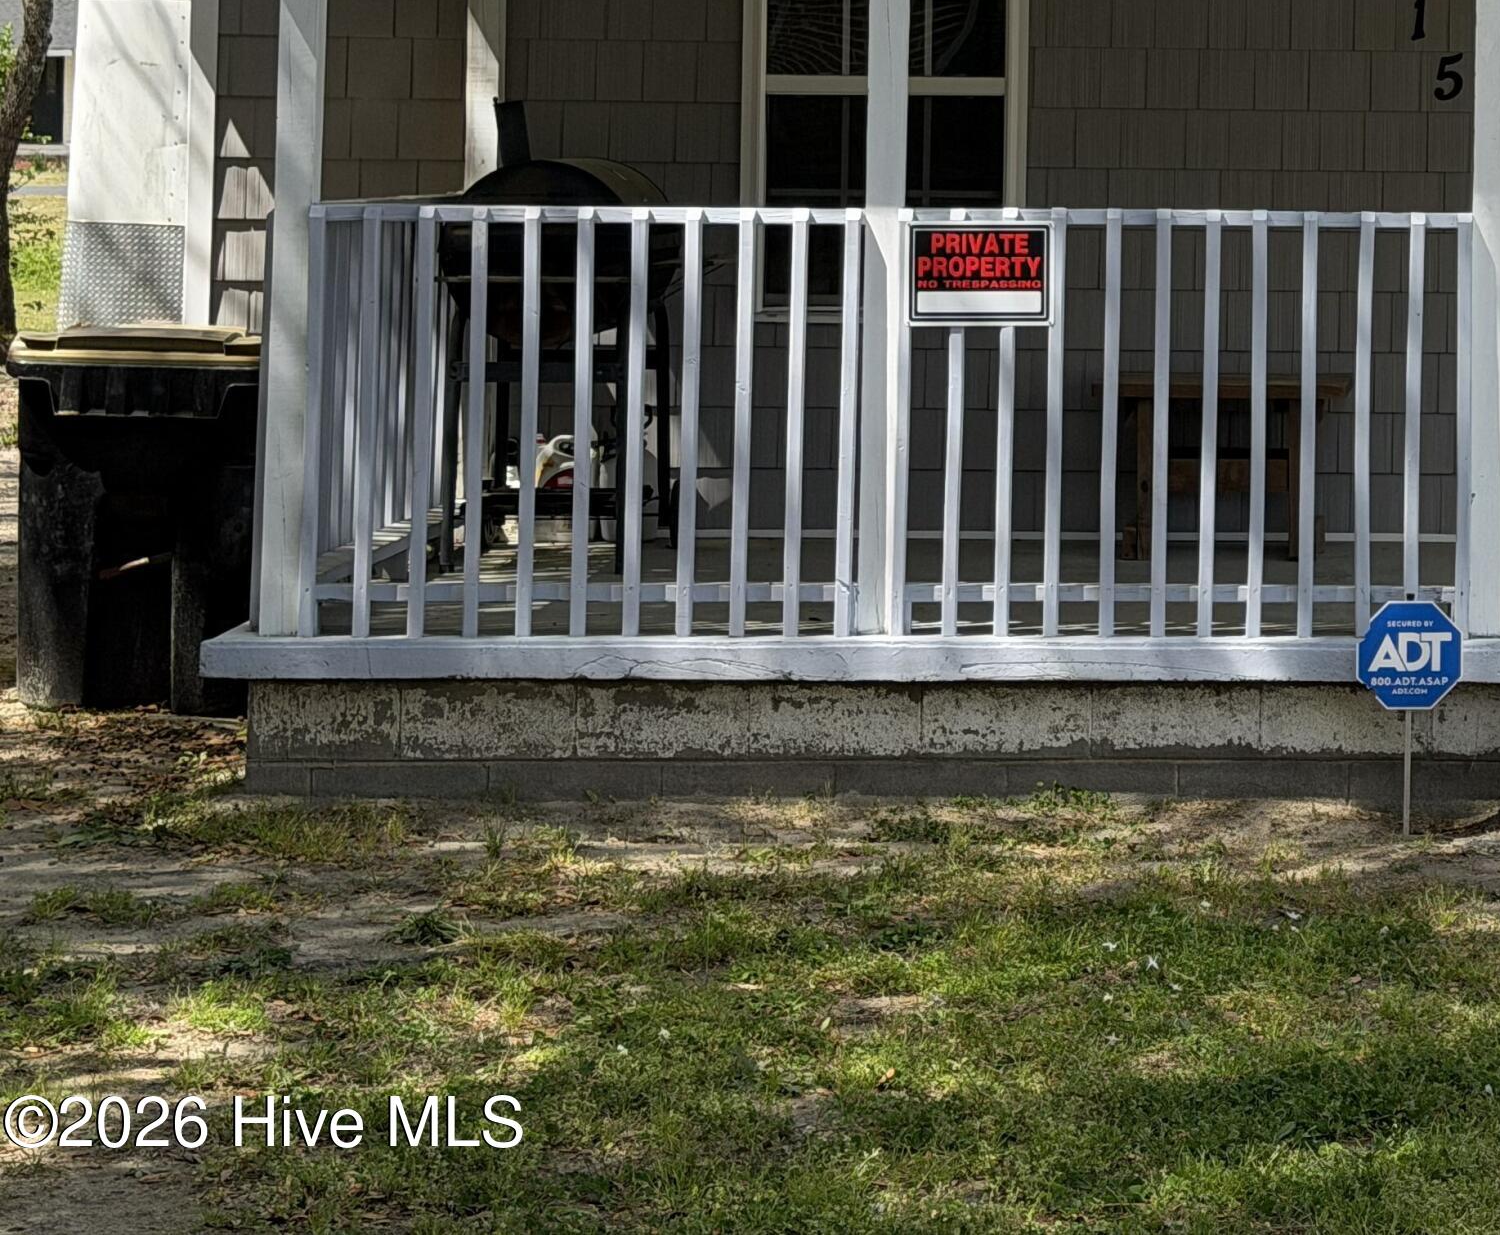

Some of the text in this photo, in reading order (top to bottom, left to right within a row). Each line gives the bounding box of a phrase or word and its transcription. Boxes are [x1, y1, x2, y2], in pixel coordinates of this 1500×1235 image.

[930, 233, 1029, 254] PRIVATE
[917, 256, 1041, 278] PROPERTY
[917, 280, 1041, 289] NO TRESPASSING
[1367, 632, 1452, 672] ADT
